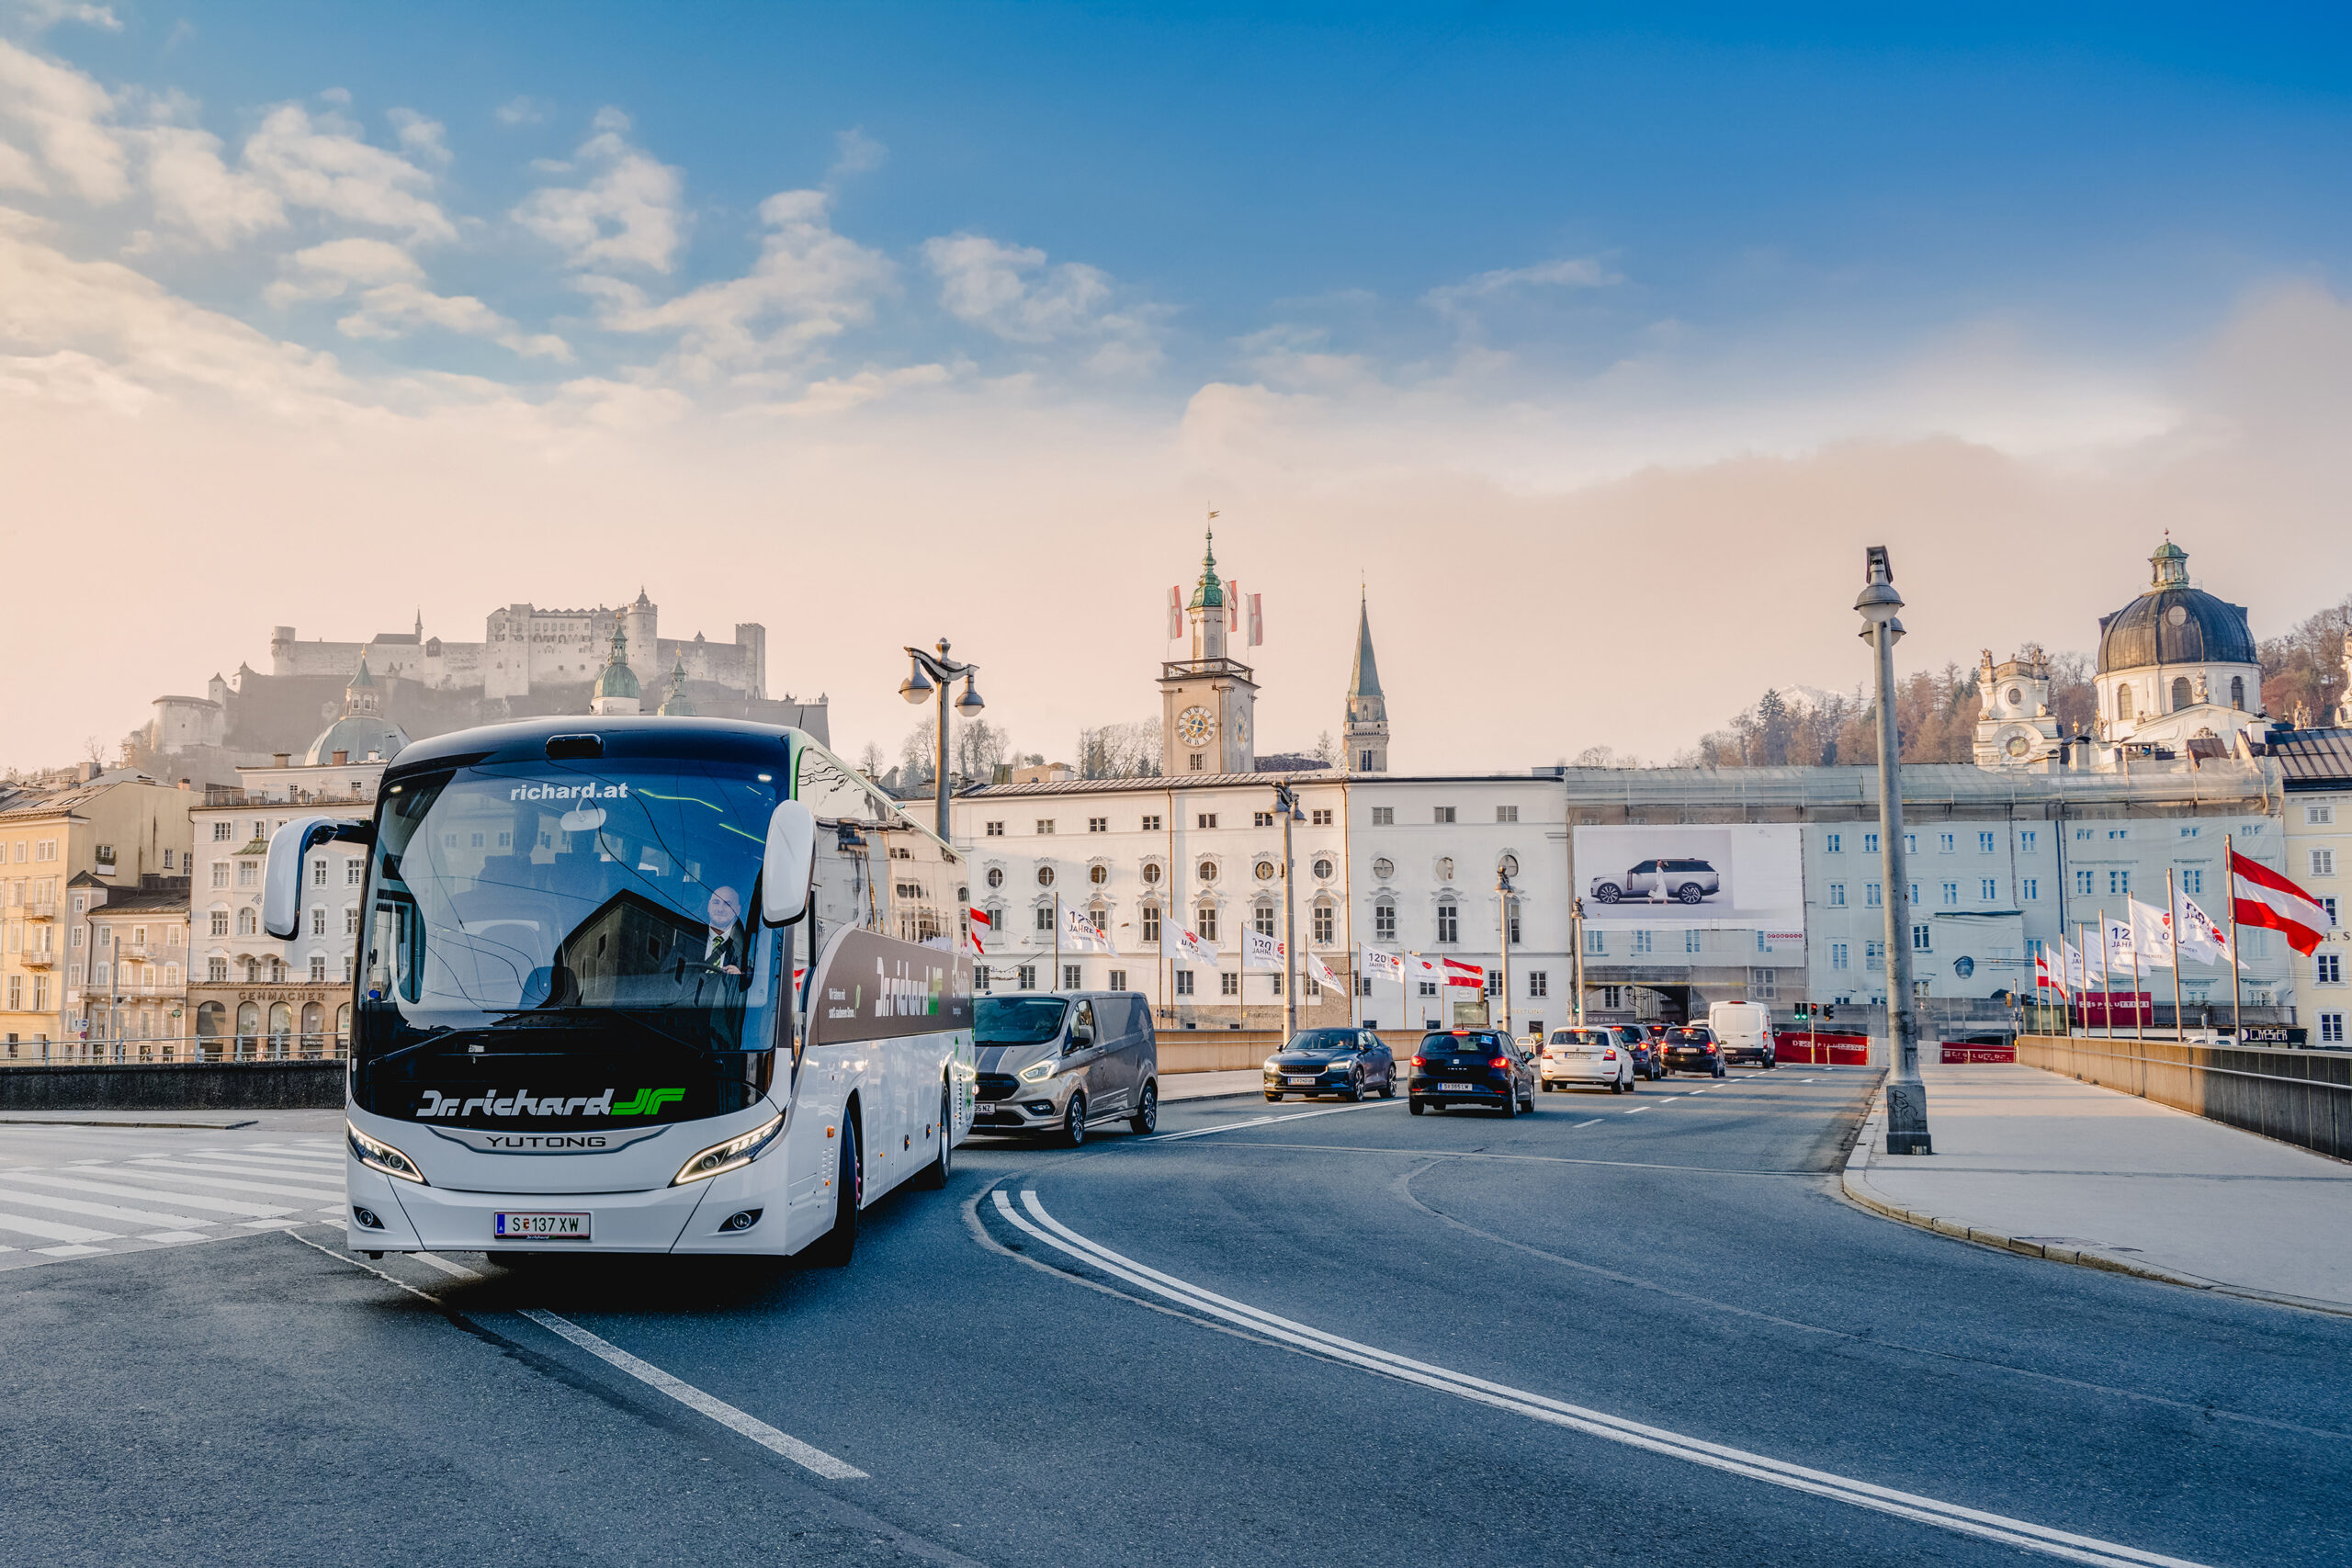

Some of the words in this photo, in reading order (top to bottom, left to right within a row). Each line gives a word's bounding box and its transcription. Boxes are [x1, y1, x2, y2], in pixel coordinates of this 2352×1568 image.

[511, 783, 628, 801] richard.at
[1069, 924, 1093, 934] JAHRE
[2111, 927, 2131, 941] 12
[1368, 953, 1386, 964] 120
[238, 991, 326, 1001] GEHMACHER
[486, 1136, 606, 1148] YUTONG
